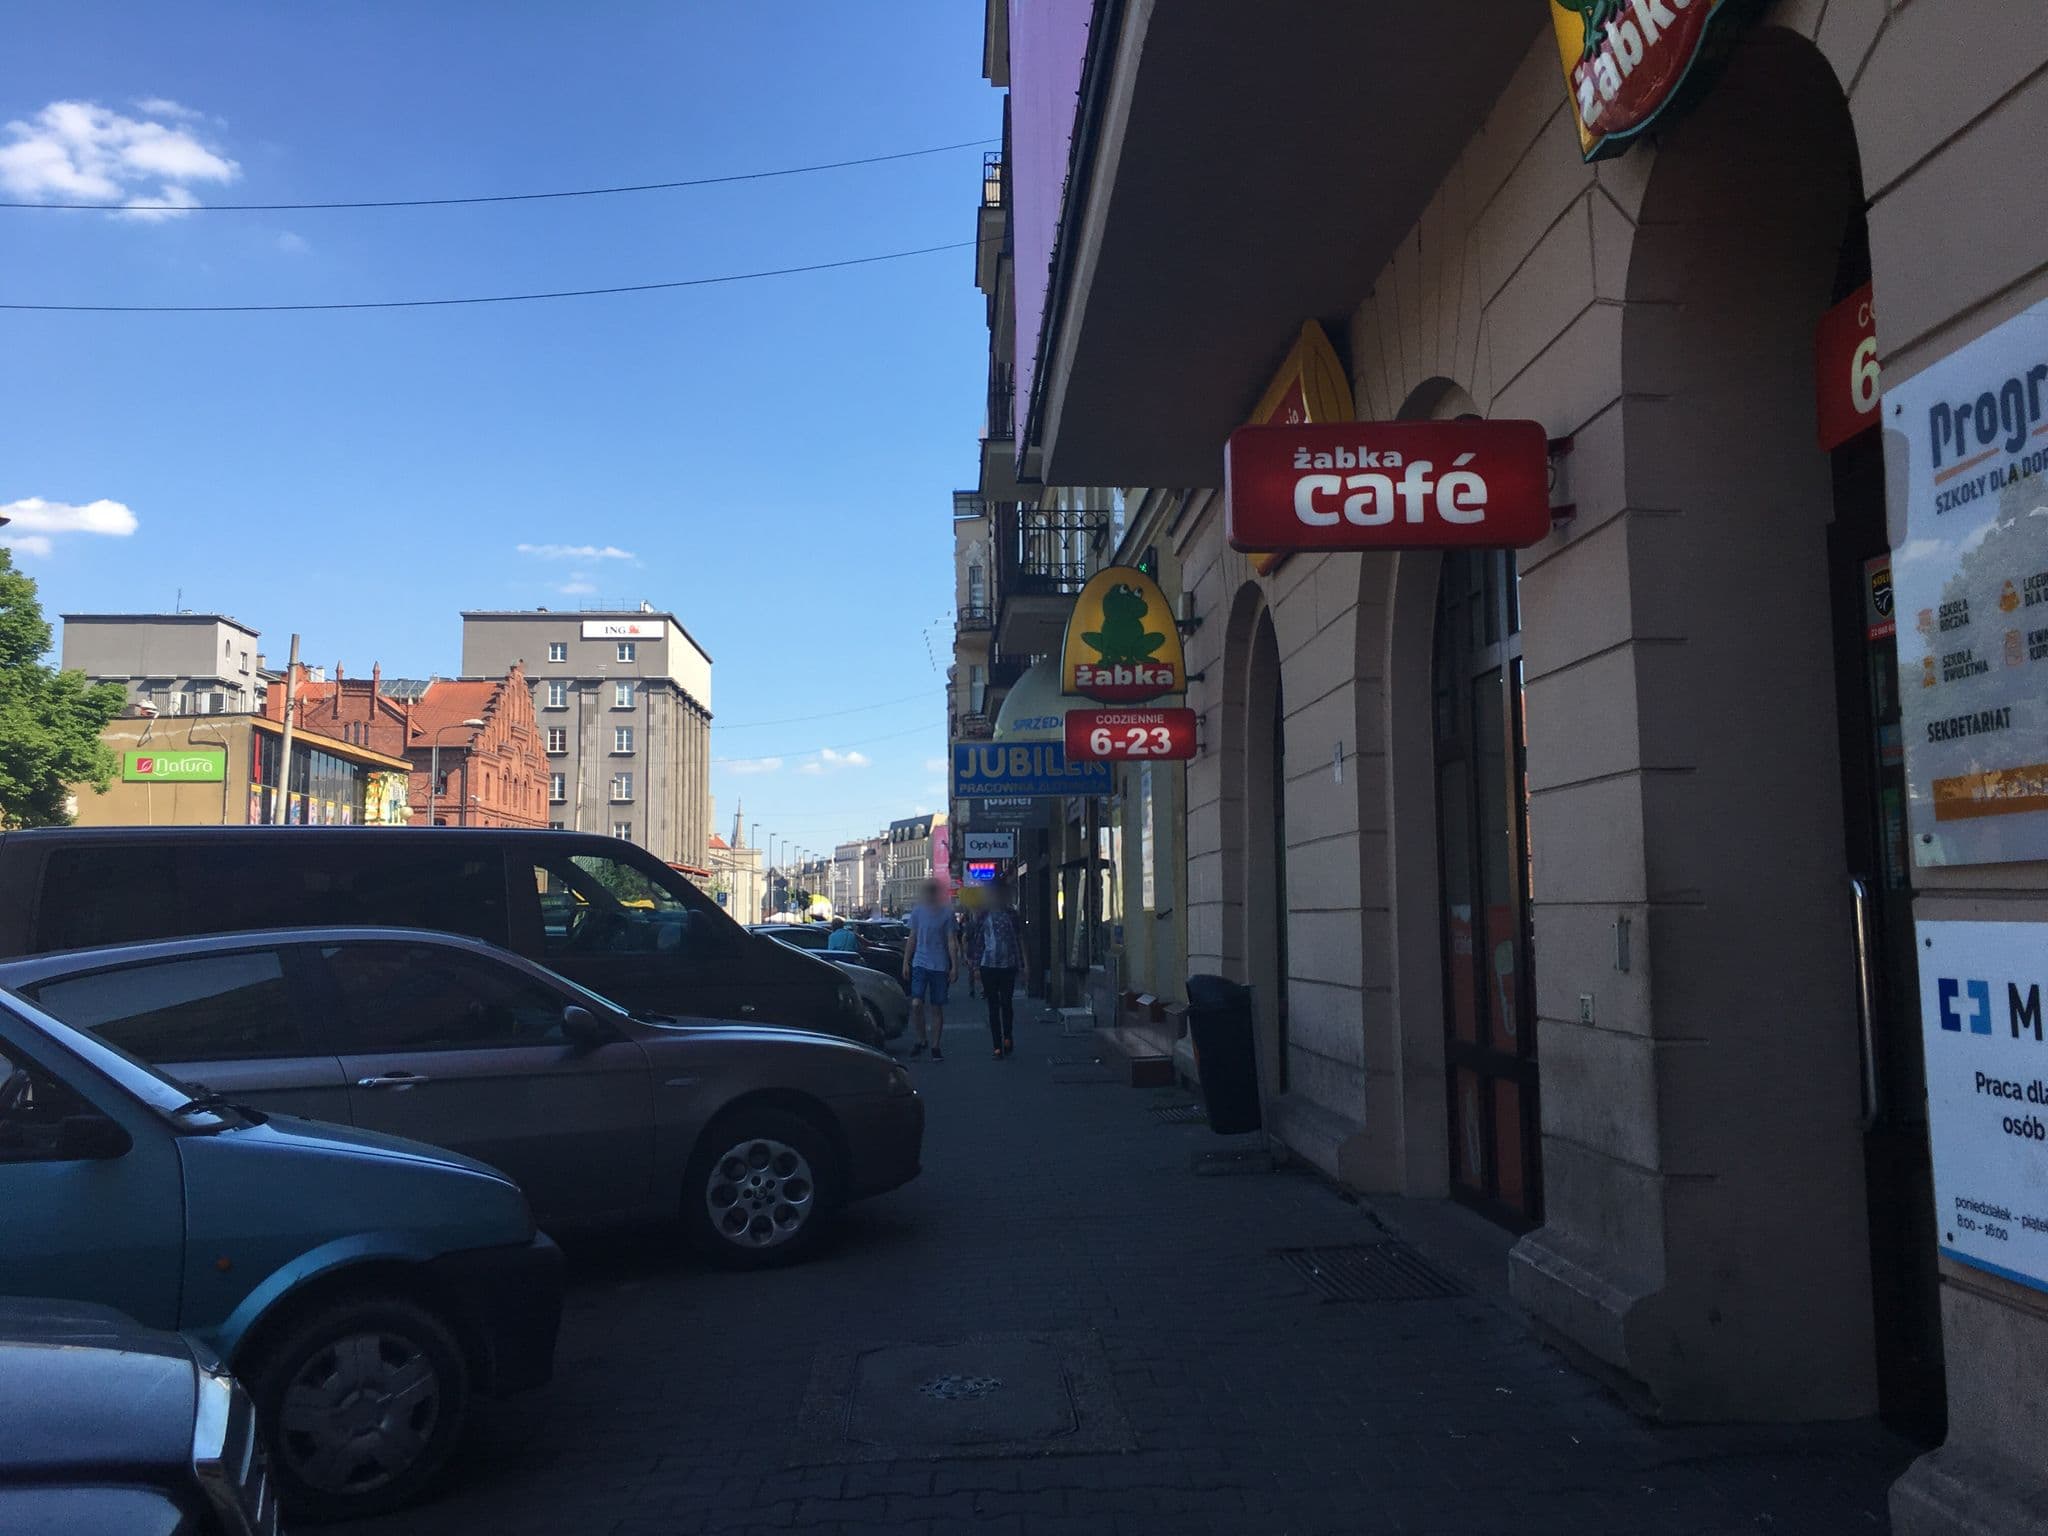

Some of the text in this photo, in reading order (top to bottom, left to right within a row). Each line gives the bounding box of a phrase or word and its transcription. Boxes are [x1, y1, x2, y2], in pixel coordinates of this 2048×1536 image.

[1574, 0, 1691, 127] żabk
[1294, 446, 1402, 469] żabka
[1294, 453, 1488, 526] café
[1935, 475, 1986, 515] SZKOŁY
[1990, 462, 2018, 492] DLA
[605, 626, 626, 634] ING
[1076, 664, 1173, 686] żabka
[1096, 714, 1164, 724] CODZIENNIE
[1926, 706, 2011, 743] SEKRETARIAT
[1090, 727, 1172, 755] 6-23
[970, 840, 1009, 853] Optykus
[1975, 1071, 2023, 1101] Praca
[2002, 1114, 2045, 1141] osób
